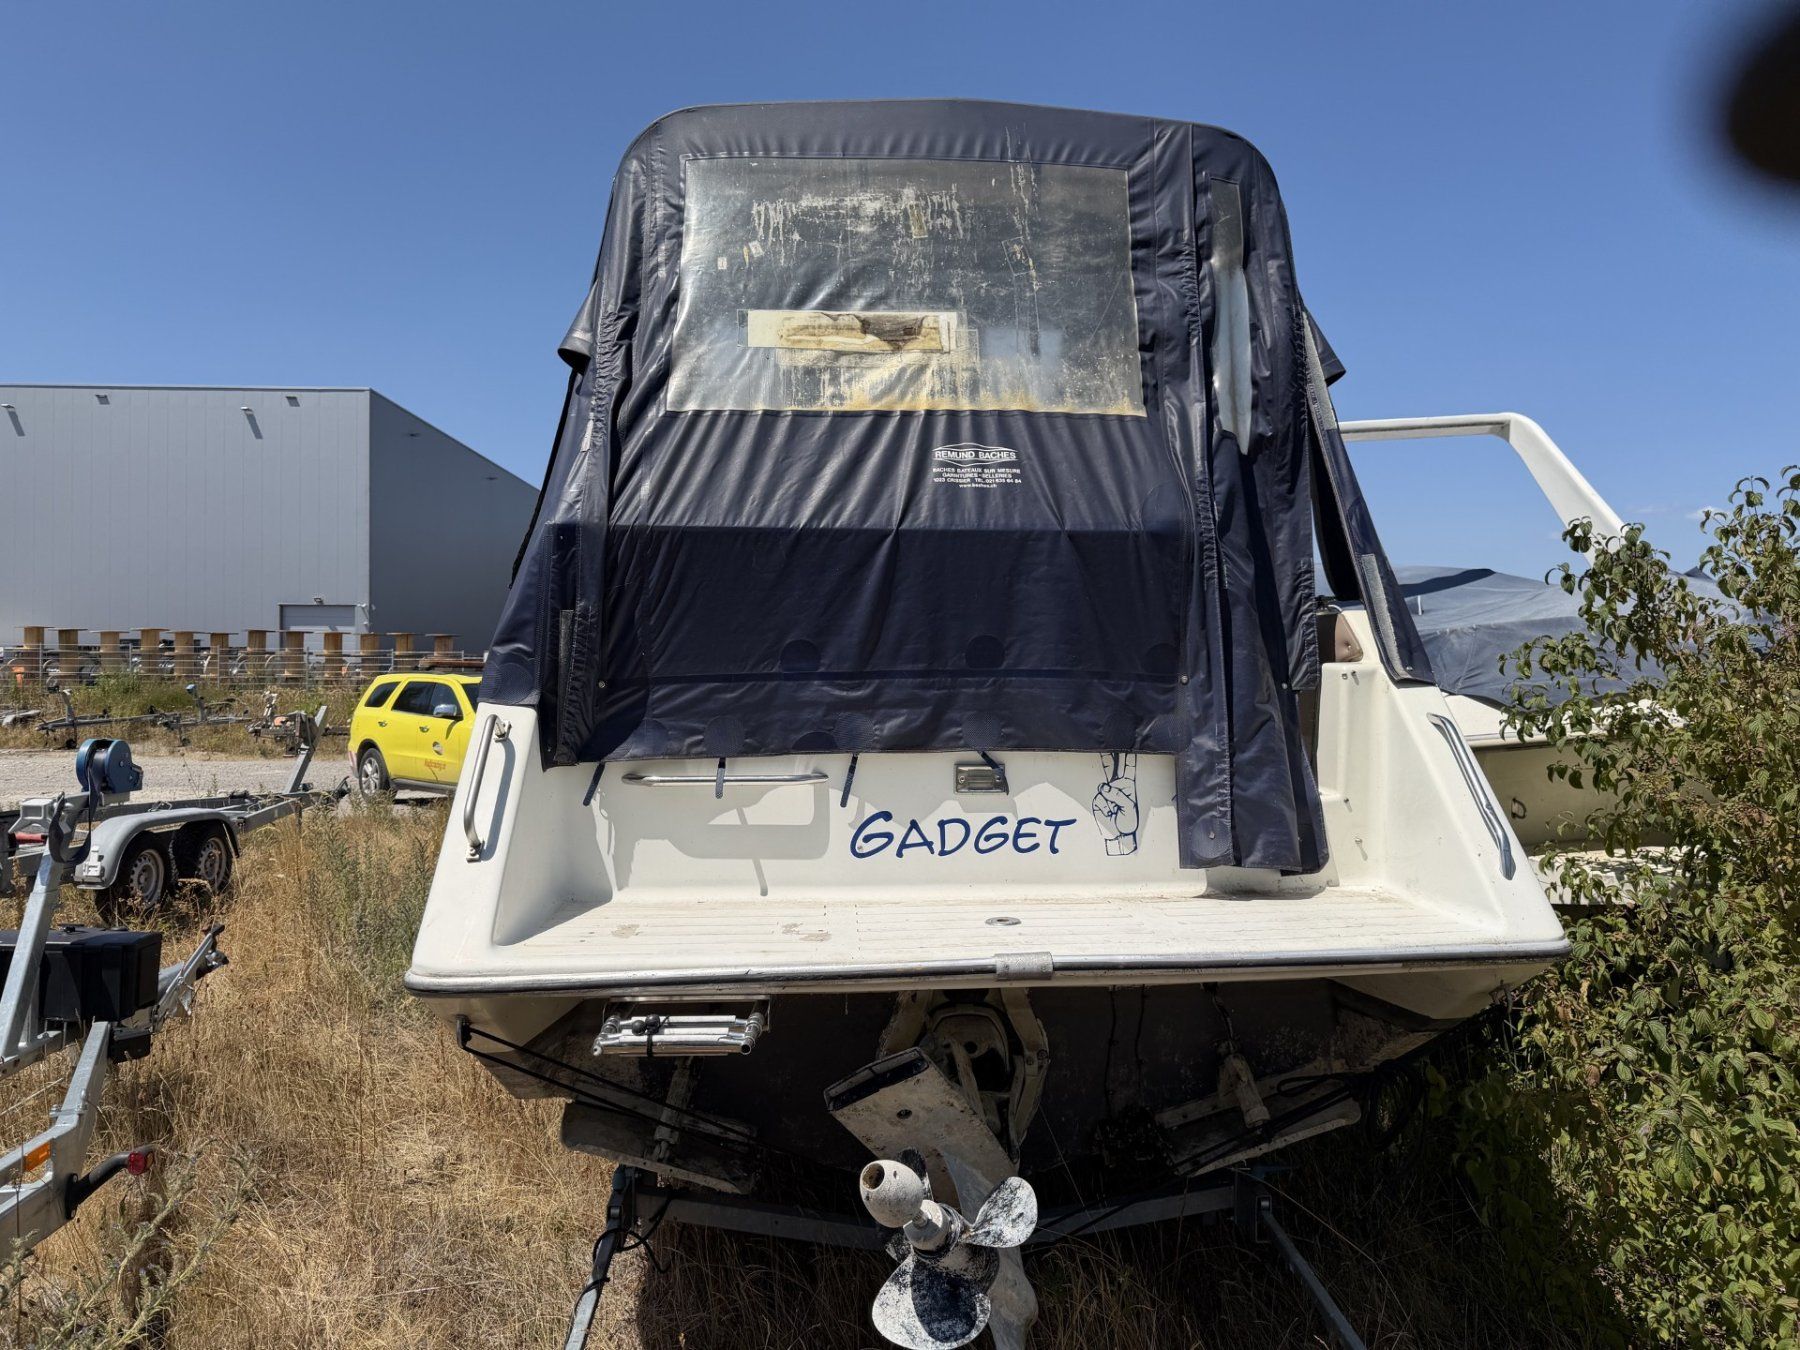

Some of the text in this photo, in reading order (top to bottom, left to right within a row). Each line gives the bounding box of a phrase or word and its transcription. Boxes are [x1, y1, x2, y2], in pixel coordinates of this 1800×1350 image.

[935, 450, 1016, 459] REMUND BACHES
[850, 810, 1077, 859] GADGET
